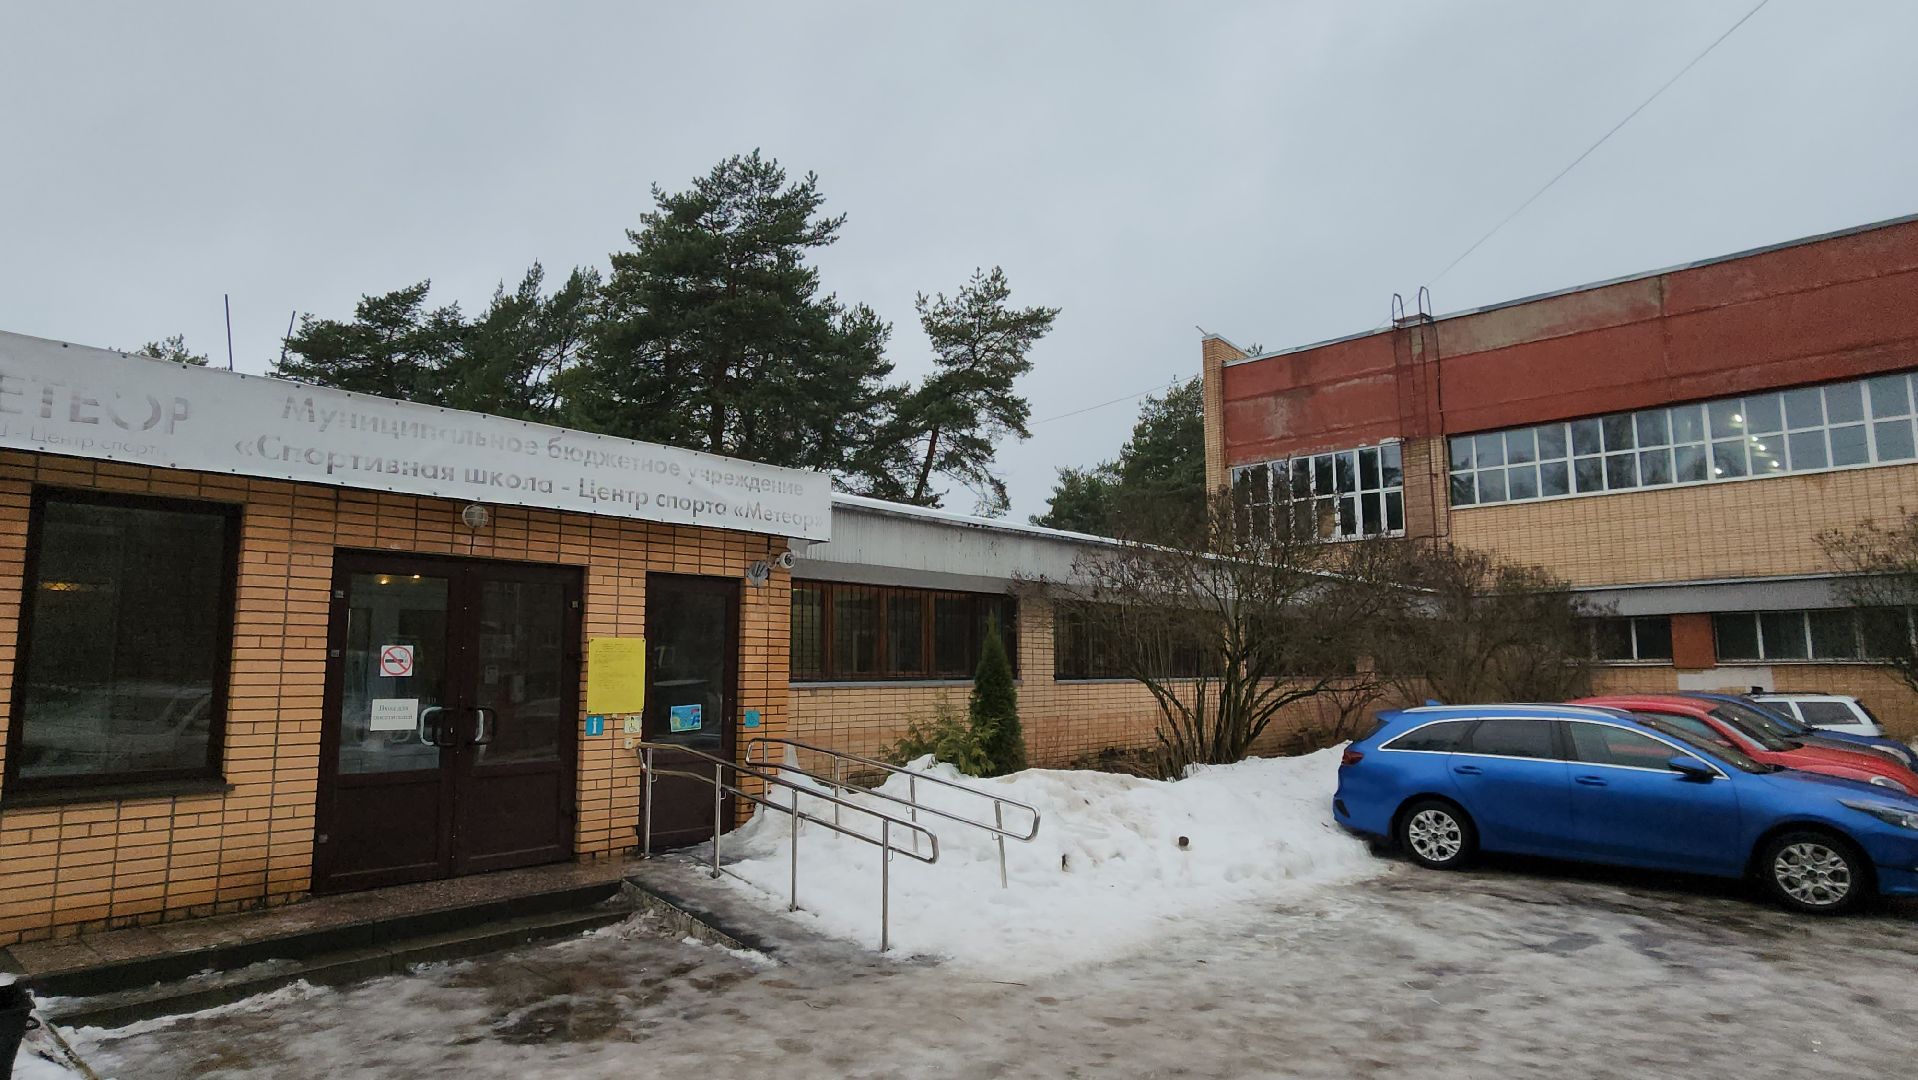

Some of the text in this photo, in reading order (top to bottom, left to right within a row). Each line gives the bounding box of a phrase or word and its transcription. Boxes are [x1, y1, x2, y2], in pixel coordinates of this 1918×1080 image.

[234, 433, 455, 482] «Спортивная
[464, 466, 553, 494] школа
[578, 477, 649, 511] Центр
[656, 492, 727, 517] спорта
[734, 501, 824, 531] «Метеор»
[547, 437, 681, 477] бюджетное
[688, 466, 804, 496] учреждение
